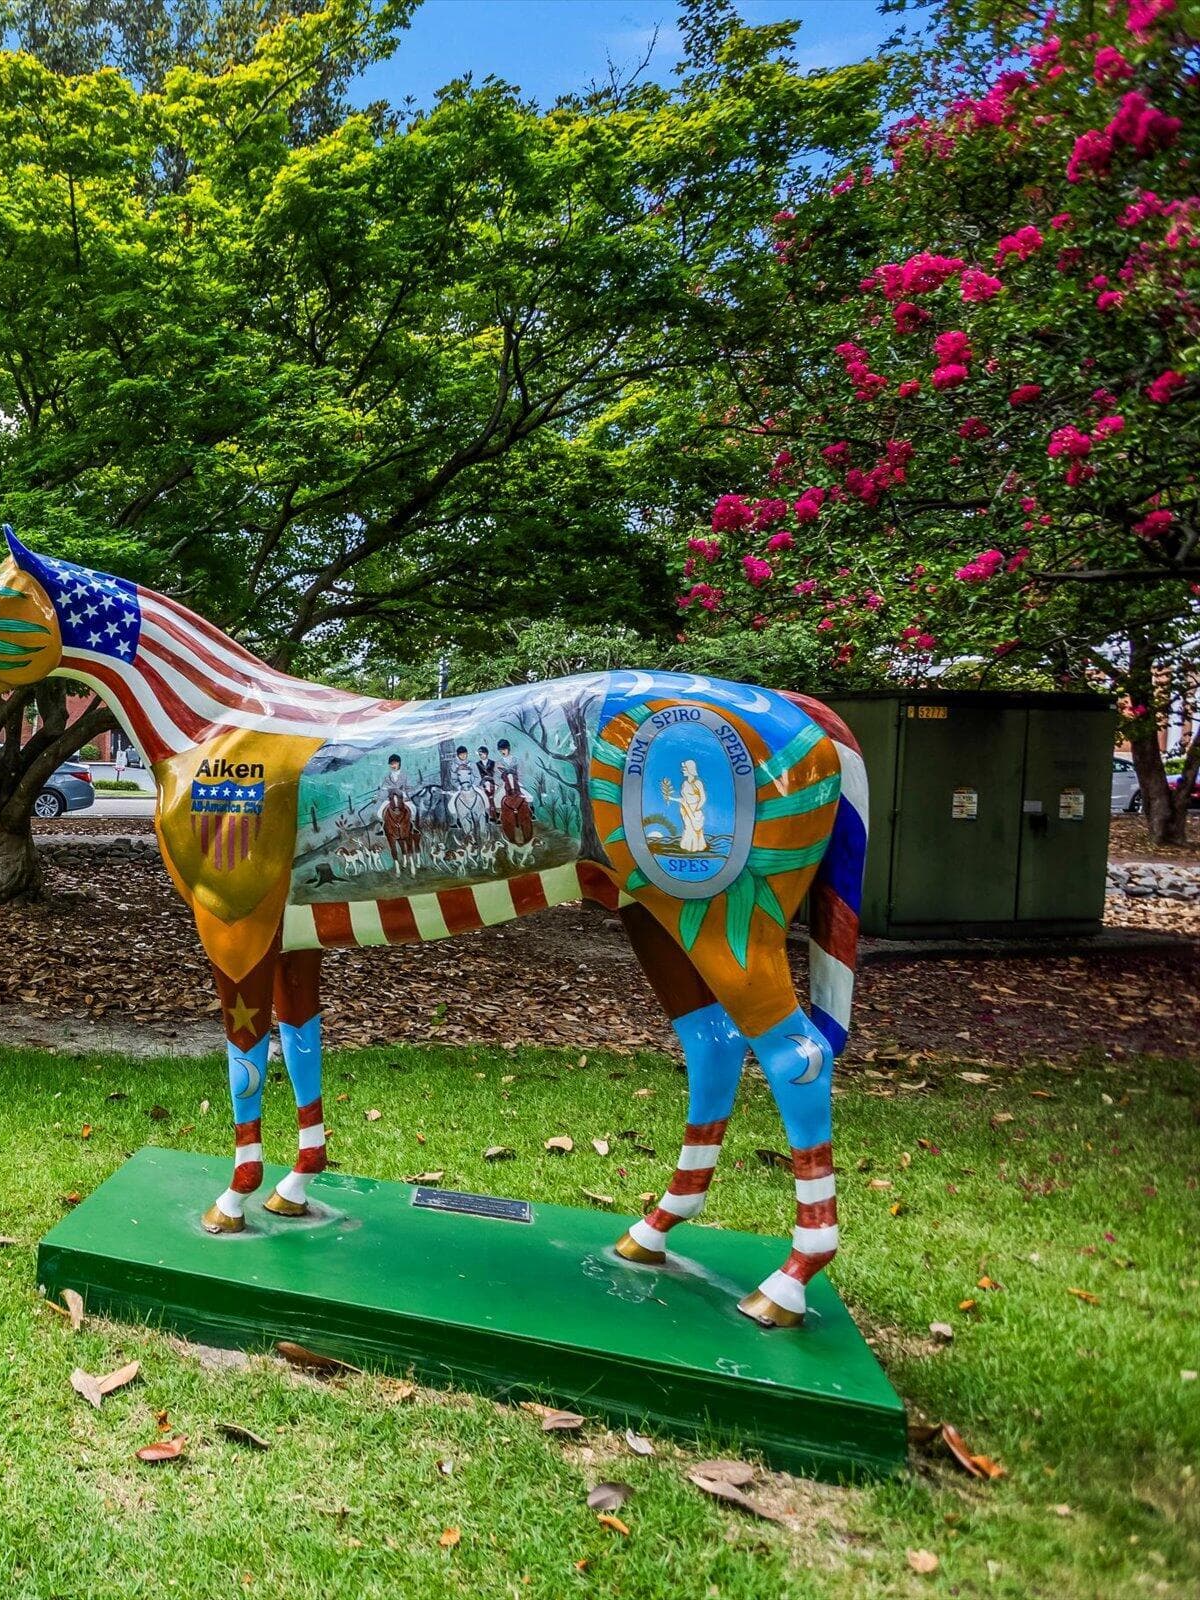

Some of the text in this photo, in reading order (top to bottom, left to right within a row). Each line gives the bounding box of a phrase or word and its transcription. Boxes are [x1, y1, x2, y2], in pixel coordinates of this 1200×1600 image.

[628, 708, 752, 776] DUM SPIRO SPERO
[195, 758, 264, 779] Aiken
[668, 859, 710, 872] SPES
